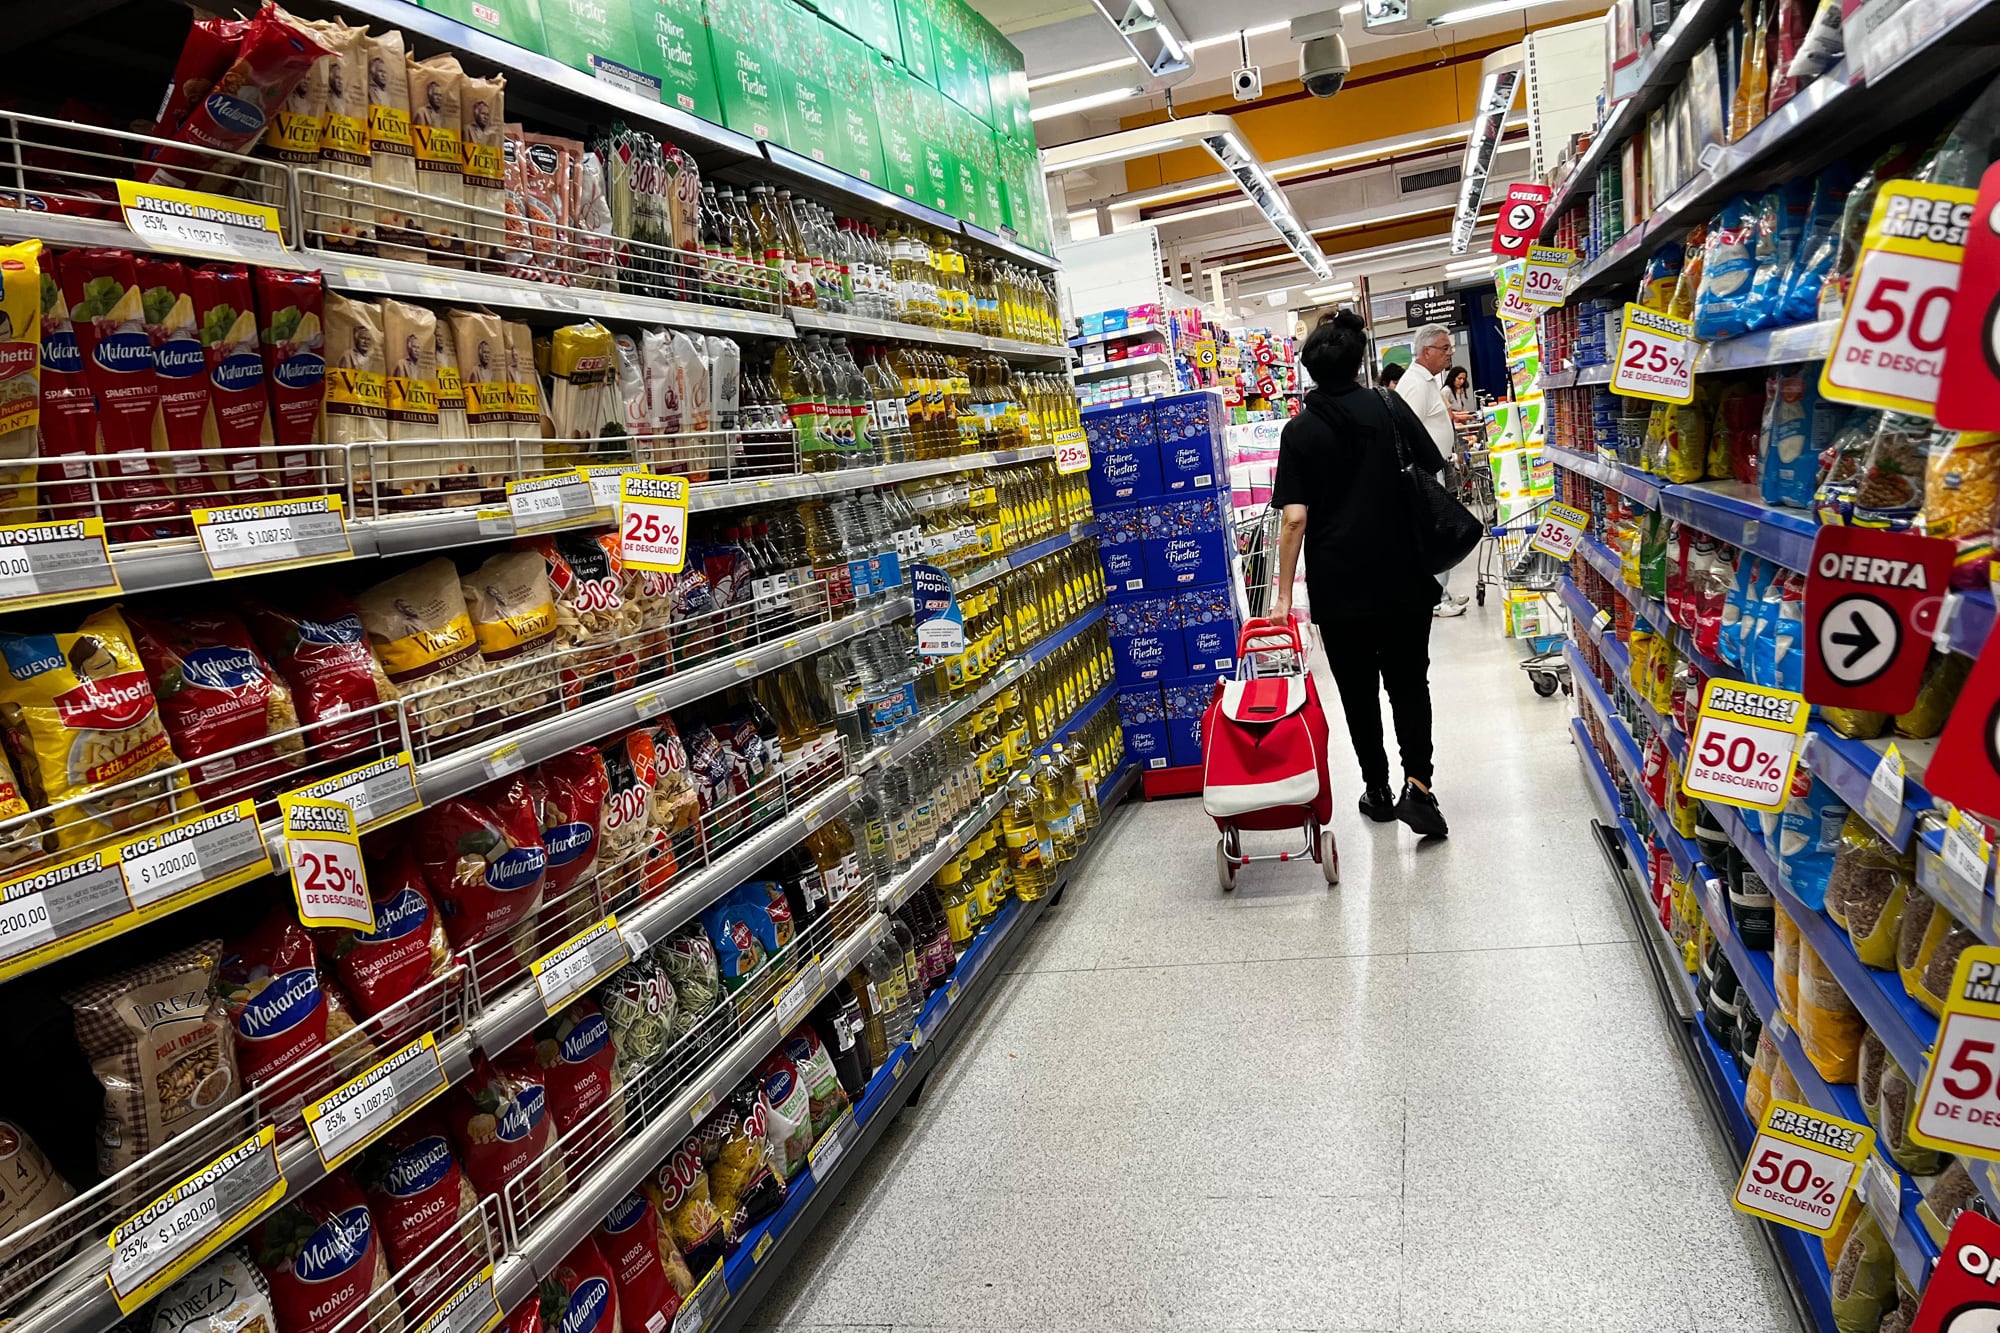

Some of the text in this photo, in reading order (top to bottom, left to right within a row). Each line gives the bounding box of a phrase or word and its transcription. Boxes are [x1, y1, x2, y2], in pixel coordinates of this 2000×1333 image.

[1509, 190, 1543, 203] OFERTA
[136, 196, 267, 231] PRECIOS IMPOSIBLES!
[142, 214, 168, 233] 25%
[1526, 271, 1564, 292] 30%
[1504, 293, 1534, 314] 30%
[1856, 277, 1958, 353] 50
[0, 349, 33, 364] hetti
[98, 342, 152, 361] Mataraz
[152, 350, 205, 370] Matarazz
[1624, 339, 1688, 379] 25%
[1845, 346, 1873, 365] DE
[217, 362, 264, 382] Matarazz
[1621, 370, 1688, 388] DE DESCUENTO
[1059, 447, 1087, 463] 25%
[1105, 452, 1133, 465] Felices
[1104, 463, 1138, 478] Fiestas
[513, 472, 582, 494] PRECIOS IMPOSIBLES!
[208, 498, 330, 524] PRECIOS IMPOSIBLES!
[214, 528, 239, 543] 25%
[626, 513, 680, 546] 25%
[1540, 523, 1573, 549] 35%
[624, 542, 679, 556] DE DESCUENTO
[1165, 549, 1200, 563] Fiestas
[1168, 539, 1196, 551] Felices
[915, 570, 948, 584] Marca
[1818, 552, 1928, 591] OFERTA
[575, 579, 622, 612] 308
[916, 581, 951, 593] Propia
[927, 600, 949, 610] COTO
[504, 614, 551, 638] VICENTE
[1129, 647, 1162, 660] Fiestas
[1131, 637, 1158, 649] Felices
[12, 655, 65, 681] NUEVO!
[439, 652, 468, 669] MOÑOS
[179, 699, 241, 726] TIRABUZÓN
[1699, 731, 1781, 780] 50%
[96, 757, 125, 781] Fatti
[339, 755, 400, 788] IMPOSIBLES!
[1695, 767, 1779, 794] DE DESCUENTO
[607, 785, 646, 830] 308
[160, 806, 241, 846] IMPOSIBLES!
[546, 824, 592, 856] atarazzo
[2, 853, 103, 900] IMPOSIBLES!
[153, 851, 197, 880] 1.200,00
[302, 853, 364, 897] 25%
[306, 894, 367, 912] DE DESCUENTO
[487, 905, 512, 921] NIDOS
[0, 906, 47, 936] .200,00
[540, 924, 609, 971] PRECIOS IMPOSIBLES!
[353, 948, 406, 980] TIRABUZÓN
[545, 970, 560, 986] 25%
[273, 1046, 303, 1068] RIGATE
[318, 1040, 425, 1115] PRECIOS IMPOSIBLES!
[573, 1072, 598, 1092] NIDOS
[325, 1113, 346, 1132] 25%
[502, 1151, 528, 1173] NIDOS
[115, 1193, 175, 1243] PRECIOS
[176, 1135, 262, 1202] IMPOSIBLES!
[1752, 1149, 1836, 1205] 50%
[1746, 1183, 1831, 1217] DE DESCUENTO
[402, 1196, 446, 1230] MOÑOS
[120, 1235, 149, 1264] 25%
[170, 1197, 216, 1237] 1.620,00
[621, 1242, 644, 1266] NIDOS
[158, 1277, 236, 1330] PUREZA
[308, 1283, 356, 1323] MOÑOS
